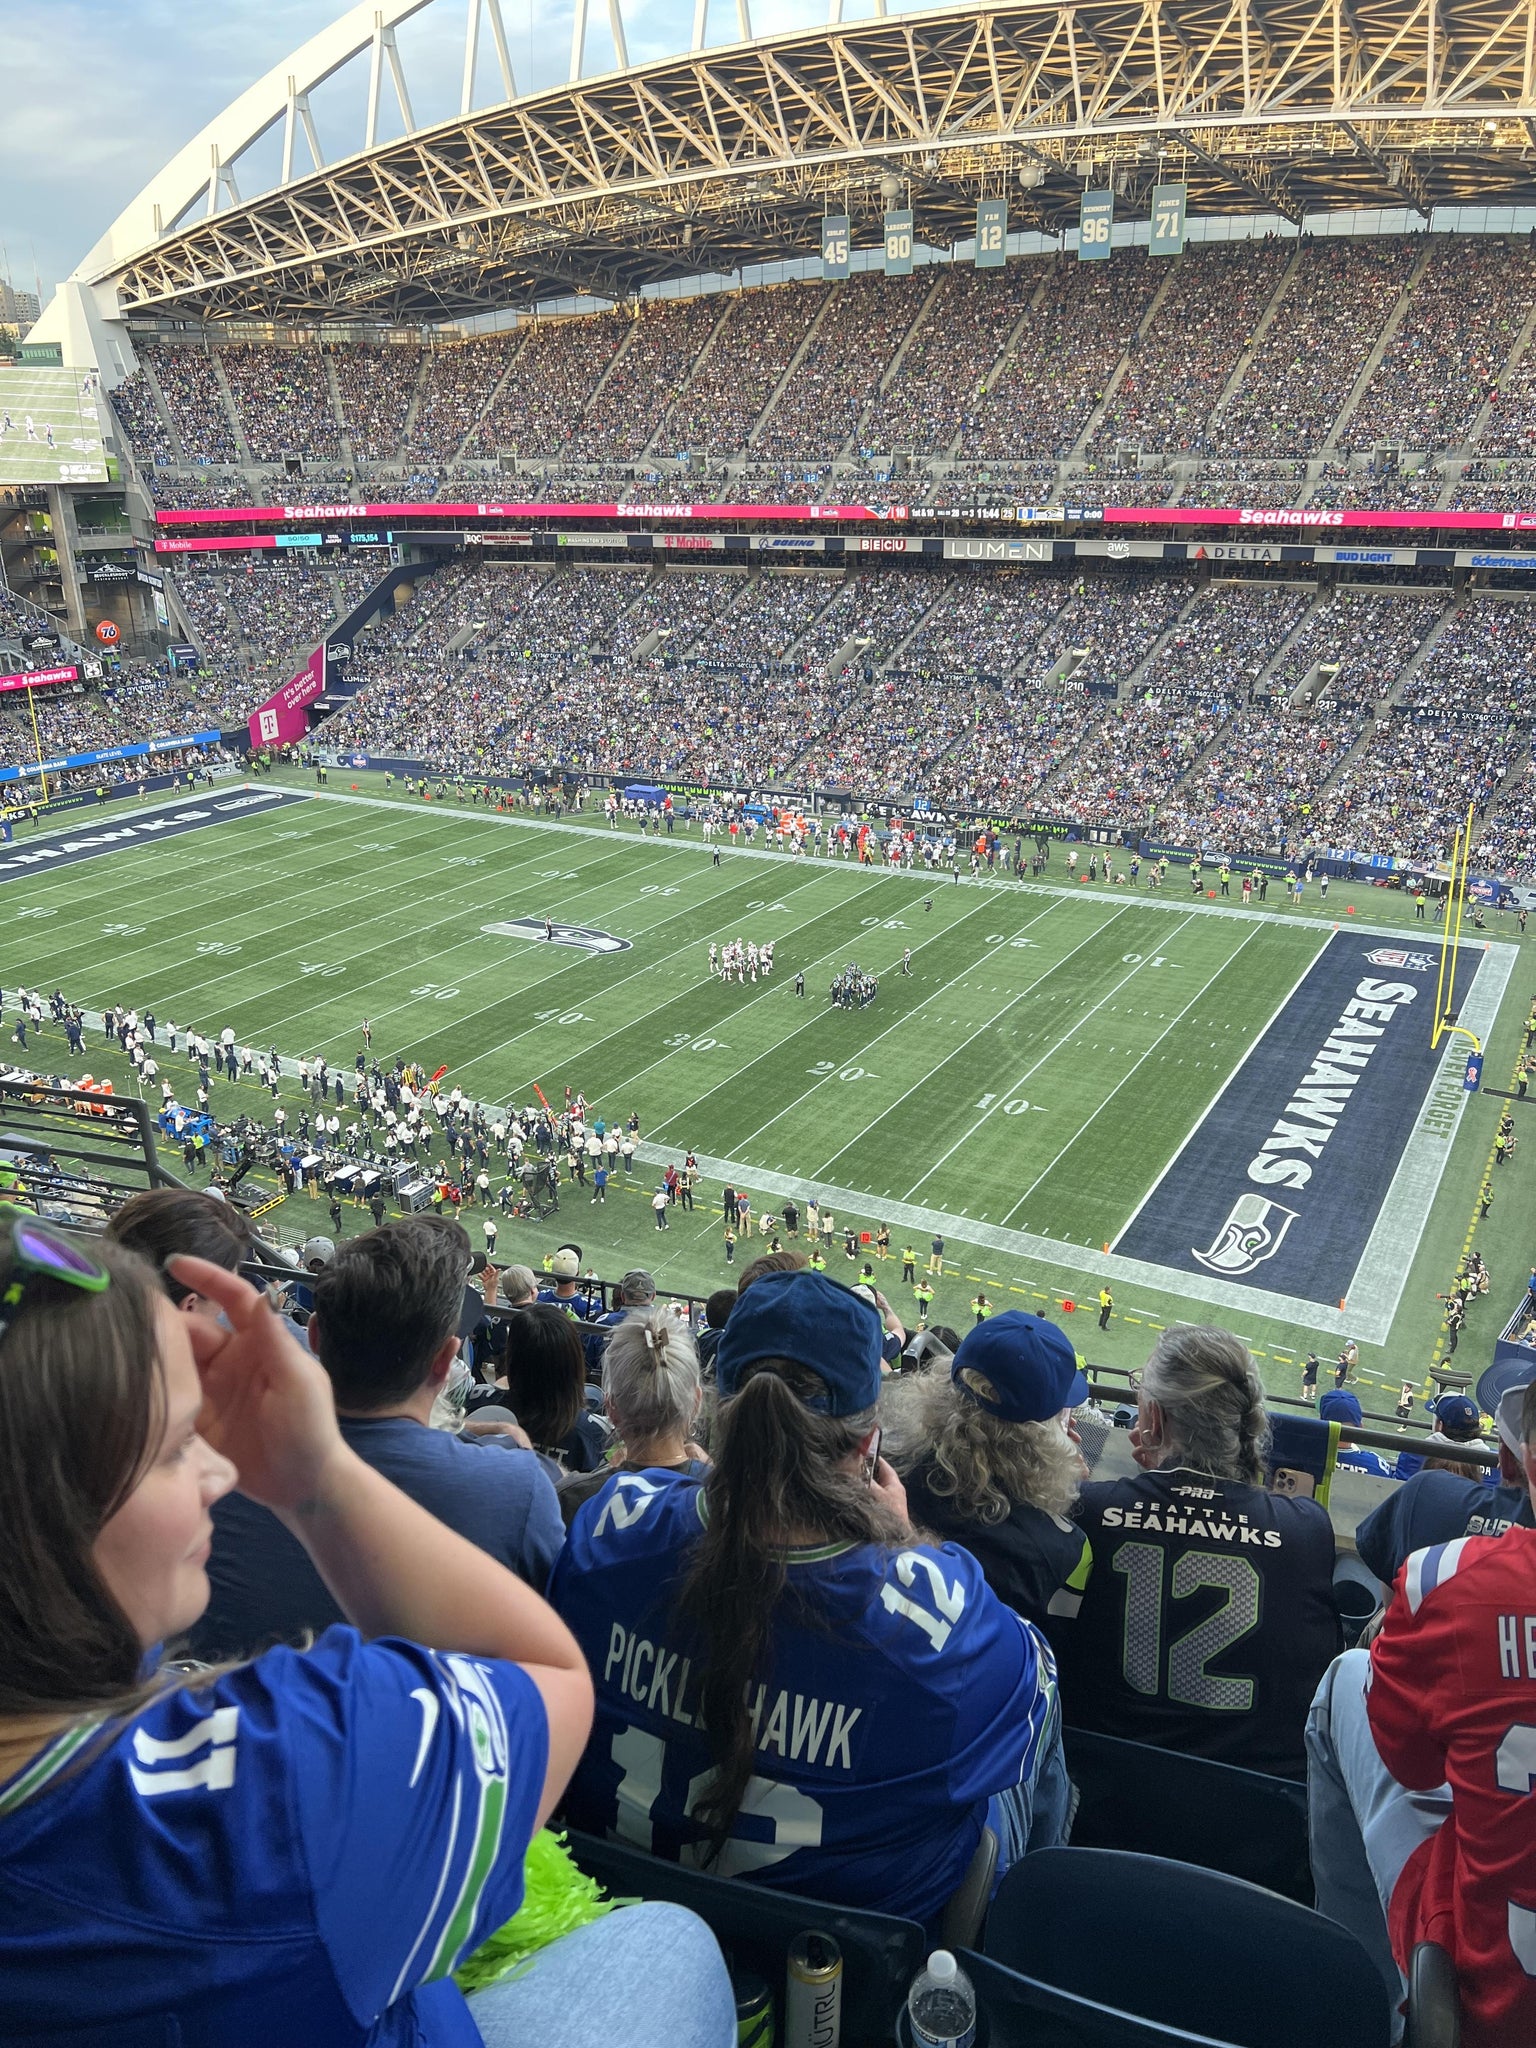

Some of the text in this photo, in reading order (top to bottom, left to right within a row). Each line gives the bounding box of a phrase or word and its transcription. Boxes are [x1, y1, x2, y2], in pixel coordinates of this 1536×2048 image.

[1082, 218, 1109, 243] 96
[1156, 212, 1178, 238] 71
[980, 226, 1002, 250] 12
[824, 241, 848, 264] 45
[887, 235, 910, 260] 80
[678, 452, 688, 460] 12
[284, 505, 366, 518] Seahawks
[616, 504, 692, 516] Seahawks
[896, 507, 906, 517] 10
[969, 509, 974, 517] 3
[977, 508, 1000, 518] 11:44
[1003, 508, 1013, 518] 25
[1022, 508, 1028, 518] 0
[1084, 510, 1102, 518] 0:00
[1239, 510, 1344, 524] Seahawks
[169, 541, 192, 550] Mobile
[466, 534, 482, 544] EQC
[676, 537, 713, 548] Mobile
[772, 539, 816, 548] BOEING
[952, 542, 1044, 560] LUMEN
[1107, 542, 1130, 552] aws
[1214, 548, 1272, 560] DELTA
[1336, 552, 1392, 562] BUD LIGHT
[101, 624, 116, 638] 76
[86, 662, 102, 678] 25
[22, 670, 72, 685] Seahawks
[342, 676, 370, 684] LUMEN
[282, 670, 316, 700] It's better
[1068, 682, 1084, 691] 210
[286, 681, 318, 709] over here
[1428, 708, 1458, 718] DELTA
[264, 715, 274, 734] T
[156, 738, 182, 750] COLUMBIA
[110, 750, 122, 758] LEVEL
[54, 760, 68, 768] BANK
[917, 801, 928, 810] 12
[1331, 849, 1344, 858] 12
[1377, 858, 1388, 868] 12
[17, 906, 58, 918] 10
[101, 924, 146, 936] 20
[860, 916, 904, 930] 30
[984, 934, 1032, 948] 20
[196, 942, 242, 956] 30
[1122, 953, 1167, 968] 10
[300, 962, 347, 977] 40
[410, 984, 460, 1000] 50
[534, 1008, 584, 1025] 40
[662, 1034, 716, 1052] 30
[806, 1061, 865, 1082] 20
[1248, 977, 1418, 1190] SEAHAWKS
[1420, 1039, 1476, 1140] NEVER FORGET
[974, 1094, 1030, 1115] 10
[1170, 1485, 1223, 1500] PRO
[1134, 1501, 1249, 1523] SEATTLE
[1102, 1508, 1282, 1548] SEAHAWKS
[880, 1551, 965, 1653] 12
[1112, 1542, 1260, 1709] 12
[604, 1622, 863, 1769] PICKLHAWK
[129, 1706, 238, 1796] 11
[607, 1724, 823, 1877] 12
